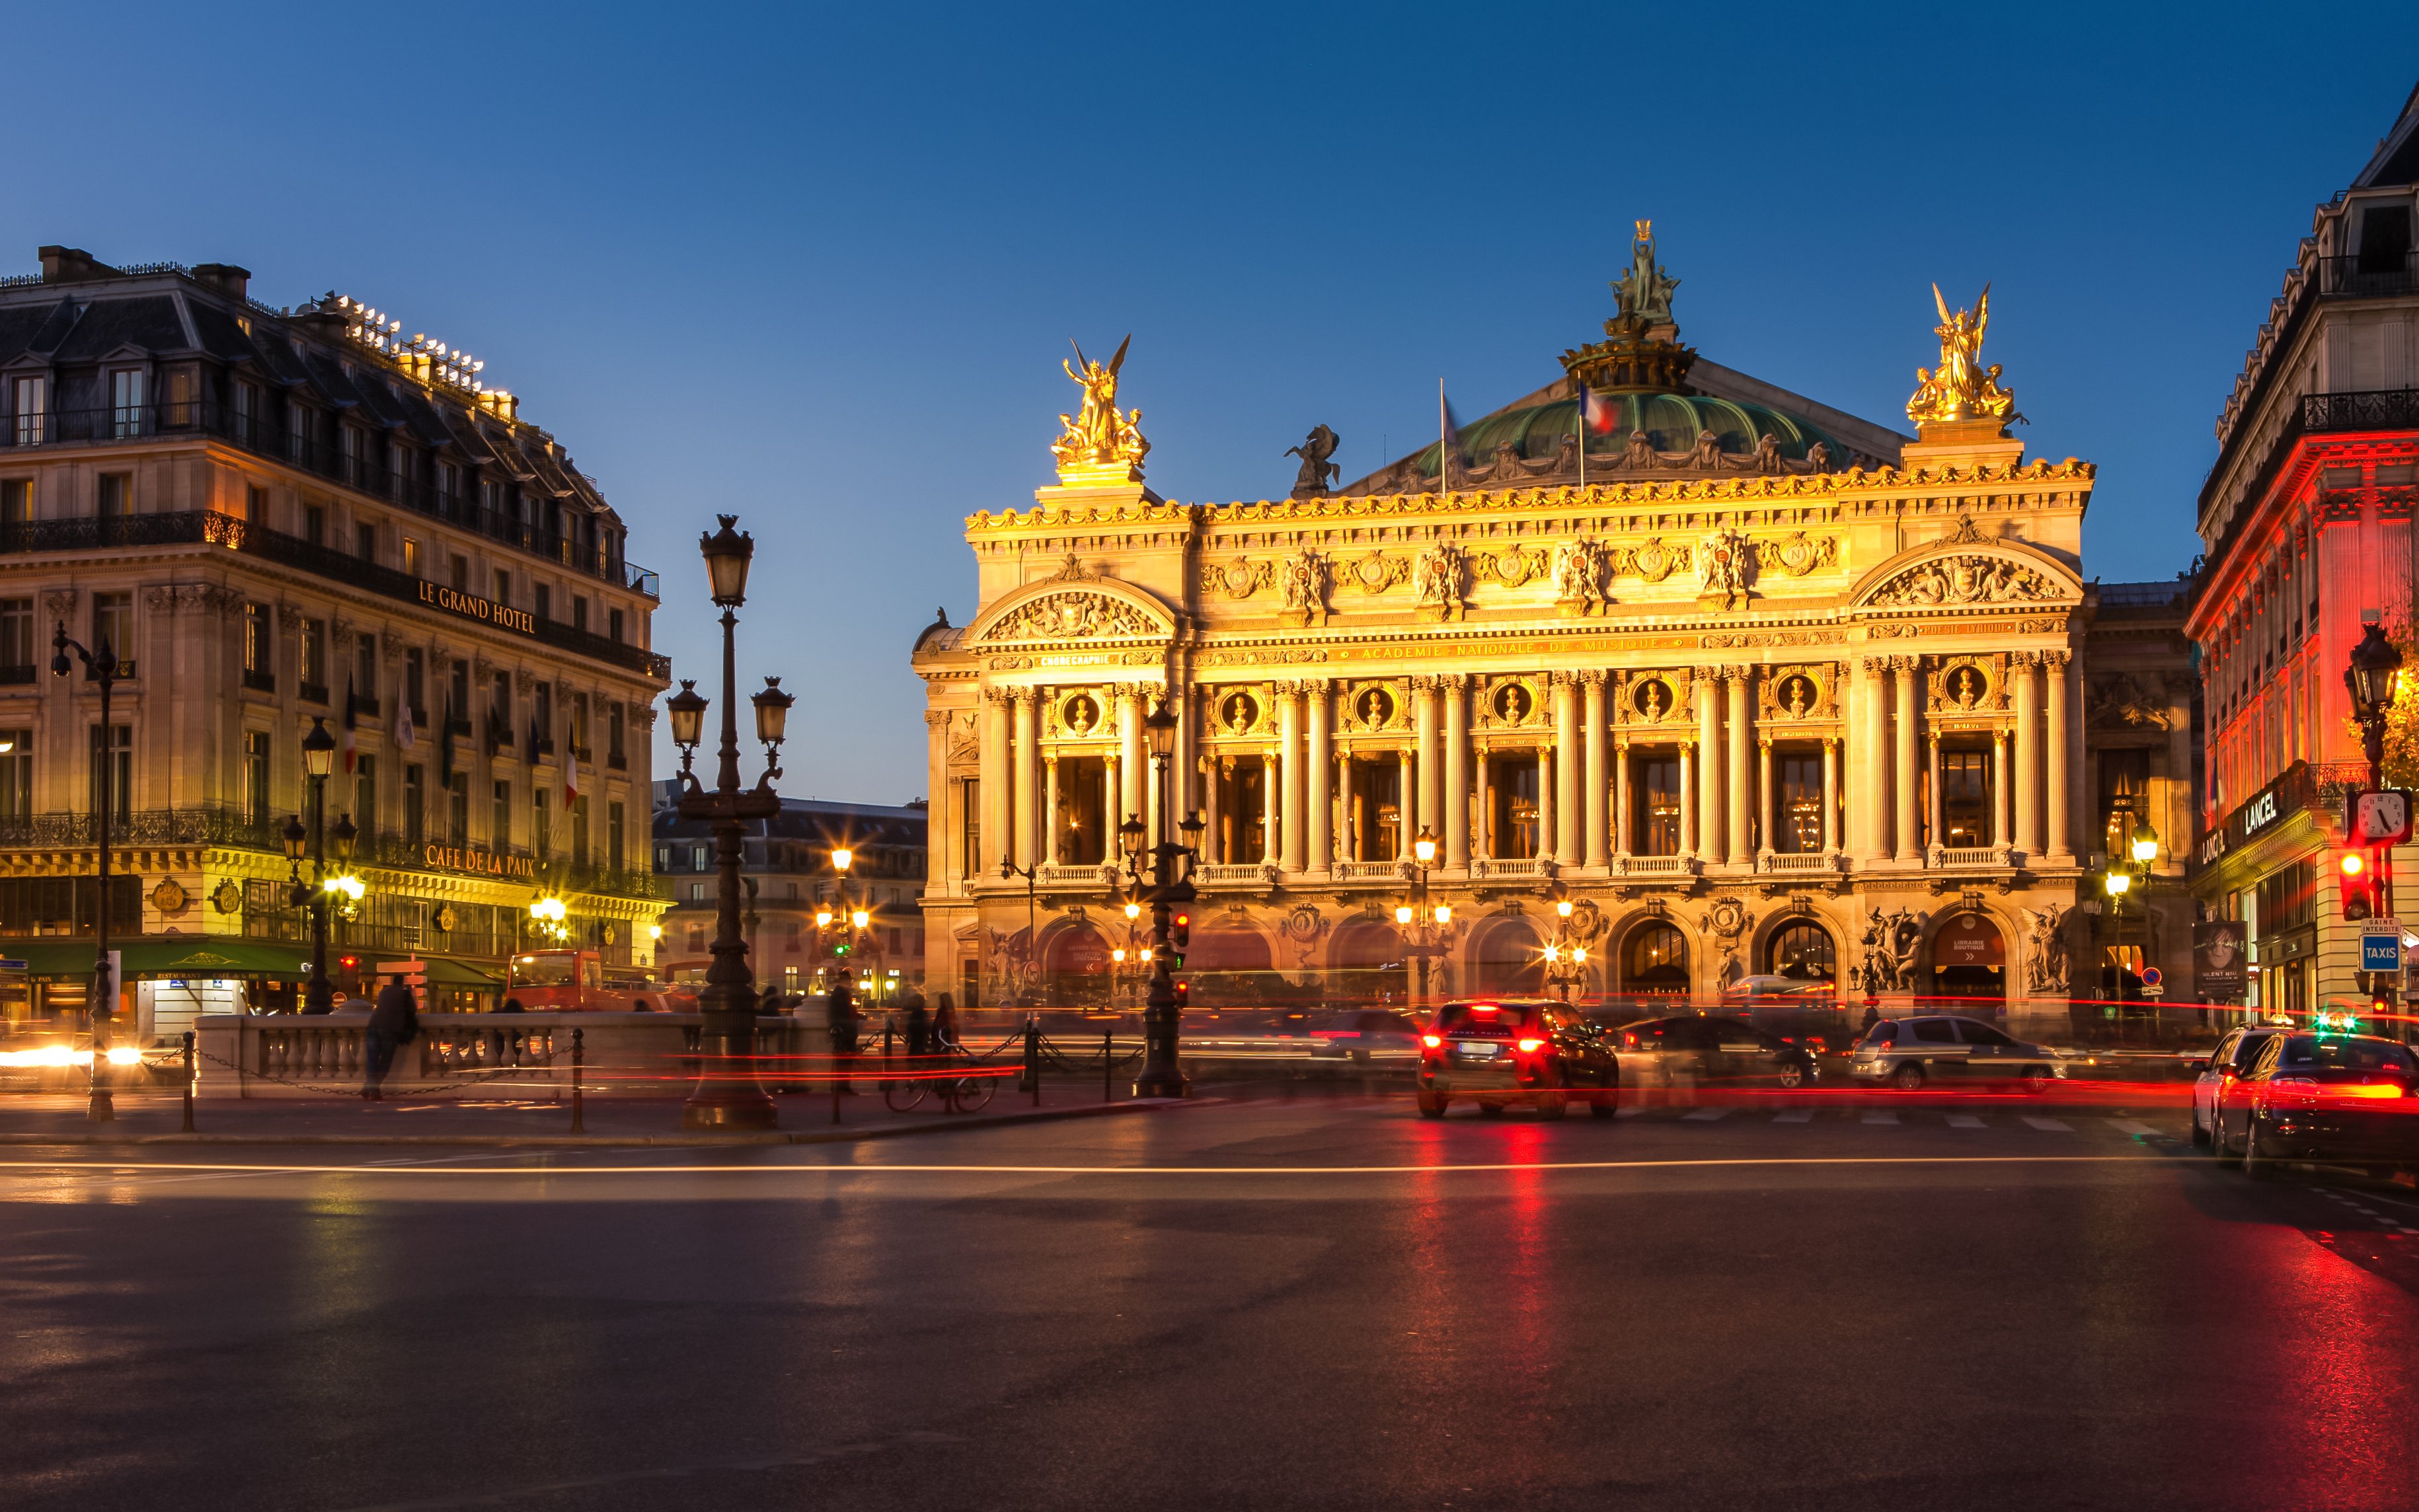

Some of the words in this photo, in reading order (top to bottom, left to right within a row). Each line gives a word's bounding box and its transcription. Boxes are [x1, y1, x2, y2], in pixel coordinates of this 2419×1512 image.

[1718, 552, 1725, 560] E
[1233, 574, 1242, 582] N
[1299, 570, 1305, 578] E
[420, 581, 434, 603] LE
[440, 588, 488, 619] GRAND
[494, 604, 535, 634] HOTEL
[1925, 625, 1961, 634] POESIE
[1362, 646, 1443, 659] ACADEMIE
[1457, 642, 1535, 656] NATIONALE
[1550, 642, 1570, 652] DE
[1586, 638, 1661, 651] MUSIQUE
[1041, 655, 1110, 666] CHOREGRAPHIE
[2246, 792, 2276, 835] LANCEL
[466, 850, 483, 871] DE
[487, 853, 502, 874] LA
[507, 856, 534, 878] PAIX
[2365, 948, 2397, 958] TAXIS
